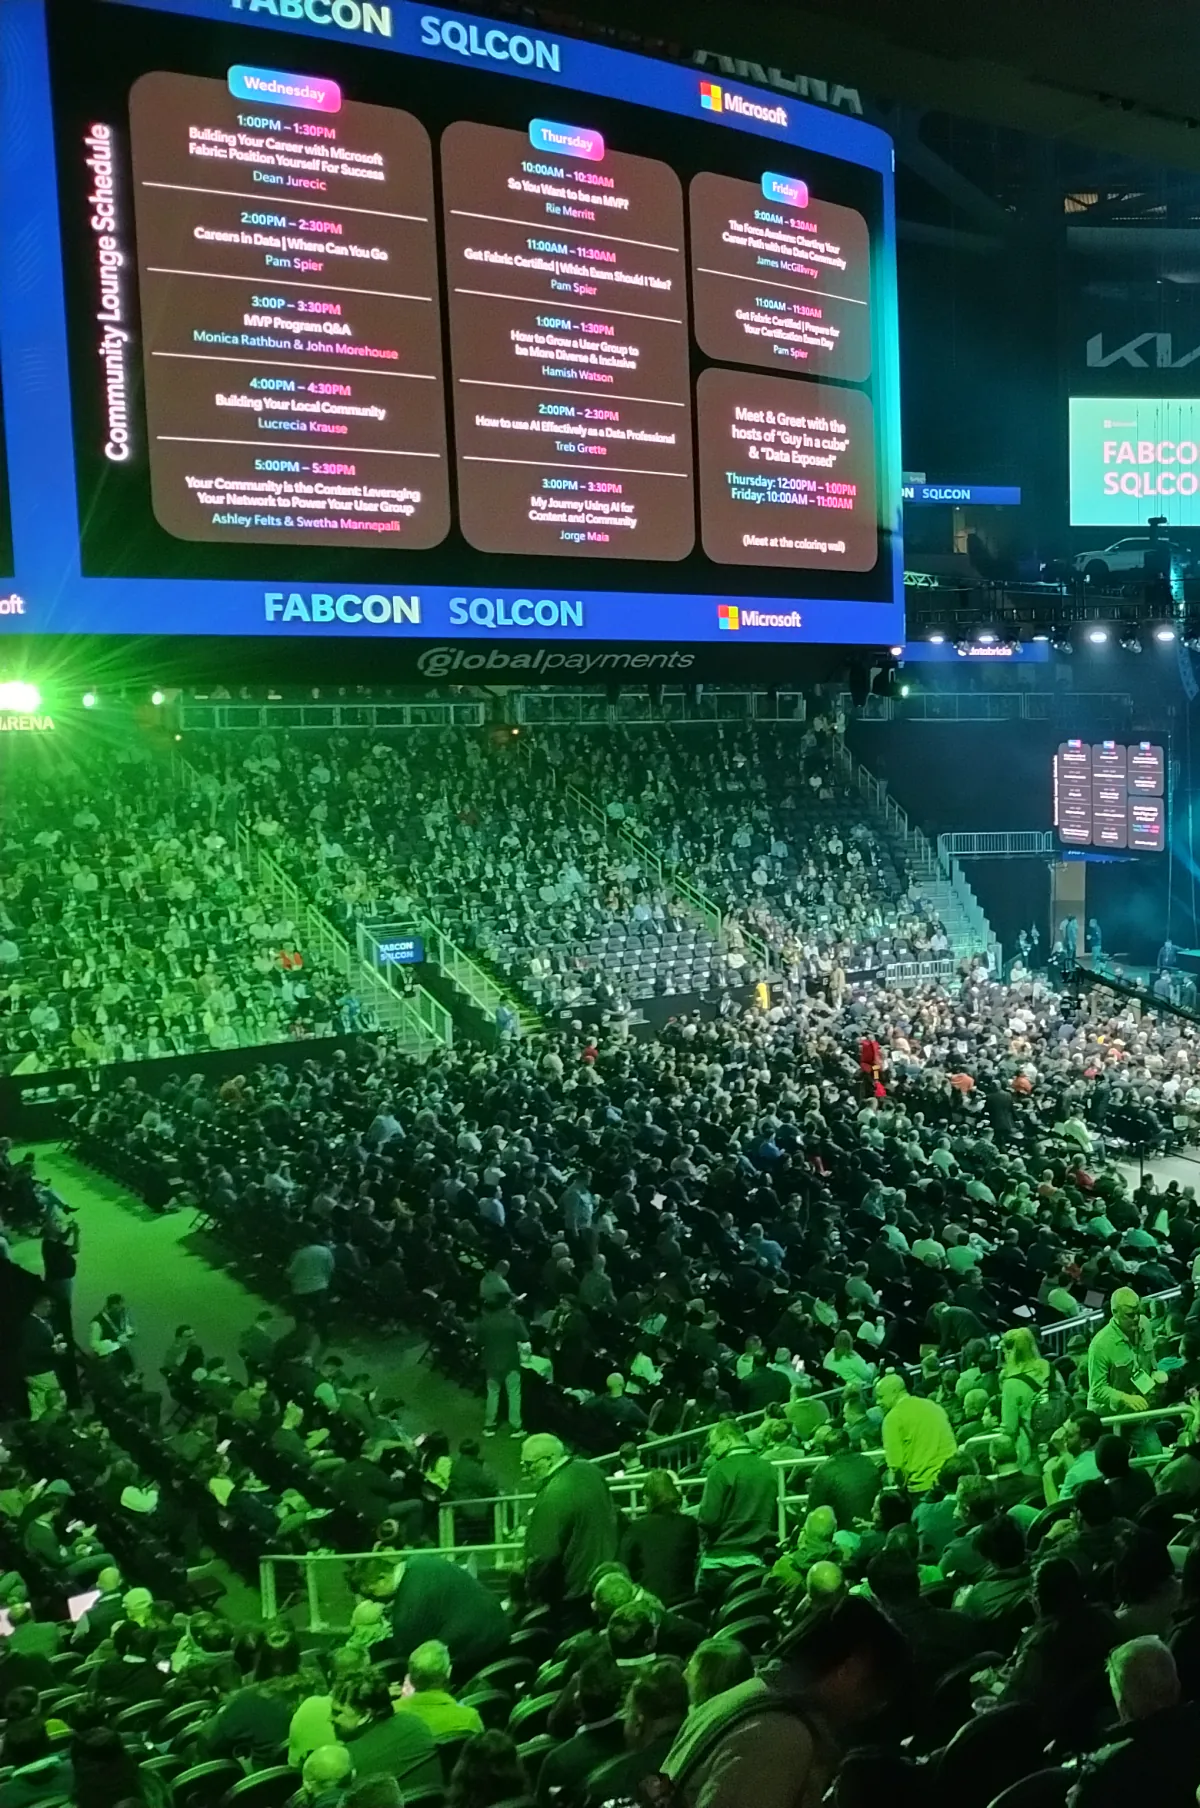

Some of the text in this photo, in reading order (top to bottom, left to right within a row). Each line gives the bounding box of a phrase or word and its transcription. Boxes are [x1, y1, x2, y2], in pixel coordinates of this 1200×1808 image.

[420, 16, 561, 72] SQLCON
[244, 76, 325, 104] Wednesday
[724, 93, 788, 127] Microsoft
[237, 115, 335, 139] 1:00PM 1:30PM
[189, 127, 383, 165] Building Your Career with Microsoft
[541, 129, 592, 153] Thursday
[229, 149, 384, 180] Position Yourself For Success
[253, 171, 327, 190] Dean Jurecic
[521, 162, 614, 188] 10:00AM 10:30AM
[508, 178, 590, 203] So You Want to be
[773, 182, 798, 199] Friday
[546, 203, 595, 220] Rie Merritt
[754, 210, 783, 225] 9:00AM
[241, 212, 342, 234] 2:00PM 2:30PM
[194, 228, 388, 260] Careers in Data Where Can You Go
[527, 239, 616, 262] 11:00AM 11:30AM
[266, 255, 323, 271] Pam Spier
[464, 248, 643, 286] Get Fabric Certified Which Should
[757, 256, 778, 268] James
[85, 123, 129, 461] Community Lounge Schedule
[551, 280, 597, 296] Pam Spier
[251, 296, 341, 315] 3:00P 3:30PM
[755, 297, 821, 318] 11:00AM 11:30AM
[244, 315, 351, 335] MVP Program Q&A
[536, 316, 614, 336] 1:00PM 1:30PM
[193, 330, 398, 359] Monica Rathbun John Morehouse
[511, 330, 639, 357] How to Grow User Group to
[774, 345, 807, 358] Pam Spier
[515, 345, 588, 363] be More Diverse
[542, 366, 613, 382] Hamish Watson
[250, 379, 351, 395] 4:00PM 4:30PM
[216, 394, 385, 419] Building Your Local Community
[539, 404, 619, 421] 2:00PM 2:30PM
[258, 418, 348, 433] Lucrecia Krause
[475, 416, 528, 430] How to use
[735, 407, 846, 433] Meet Greet with the
[732, 425, 820, 447] hosts of in a
[555, 441, 575, 452] Treb
[255, 460, 355, 475] 5:00PM 5:30PM
[185, 477, 420, 503] Your Community is the Leveraging
[542, 479, 622, 493] 3:00PM 3:30PM
[726, 472, 856, 495] Thursday: 12:00PM 1:00PM
[197, 492, 414, 516] Your Network to Power Your User Group
[732, 488, 852, 509] Friday: 10:00AM 11:00AM
[922, 488, 971, 500] SQLCON
[531, 497, 609, 513] My Journey Using
[213, 514, 338, 529] Ashley Felts Swetha
[529, 510, 637, 528] Content and Community
[560, 530, 585, 543] Jorge
[770, 537, 827, 554] at the coloring
[264, 593, 583, 627] FABCON SQLCON
[741, 610, 801, 628] Microsoft
